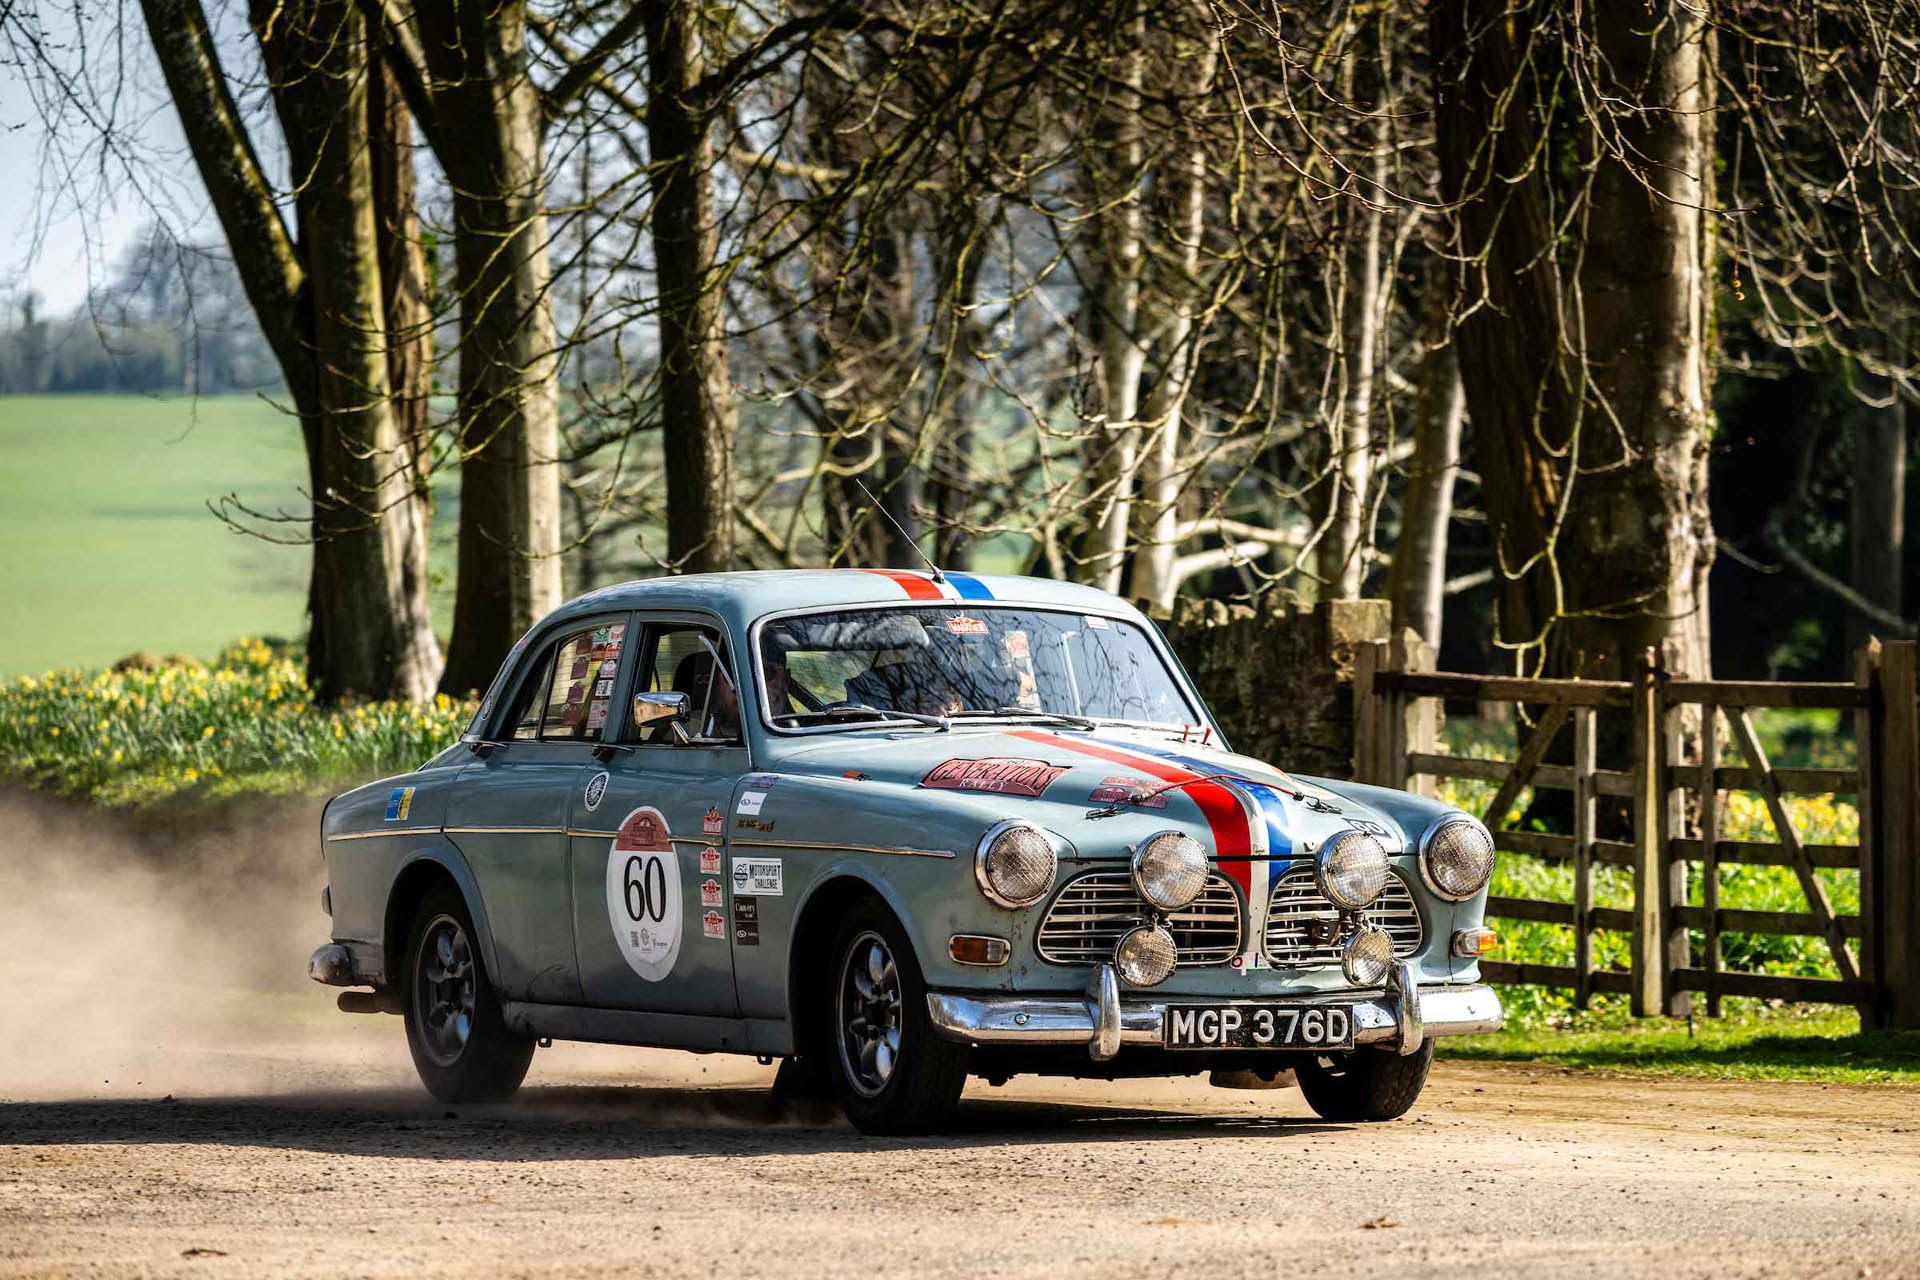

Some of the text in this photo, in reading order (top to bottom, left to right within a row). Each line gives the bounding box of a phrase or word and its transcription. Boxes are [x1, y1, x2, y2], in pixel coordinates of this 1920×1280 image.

[930, 760, 1062, 790] GENERATIONS
[960, 779, 1005, 791] RALLY
[1350, 820, 1385, 834] 60
[749, 864, 781, 881] MOTORSPORT
[624, 856, 667, 922] 60
[754, 878, 778, 890] CHALLENGE
[1172, 1009, 1348, 1044] MGP 376D
